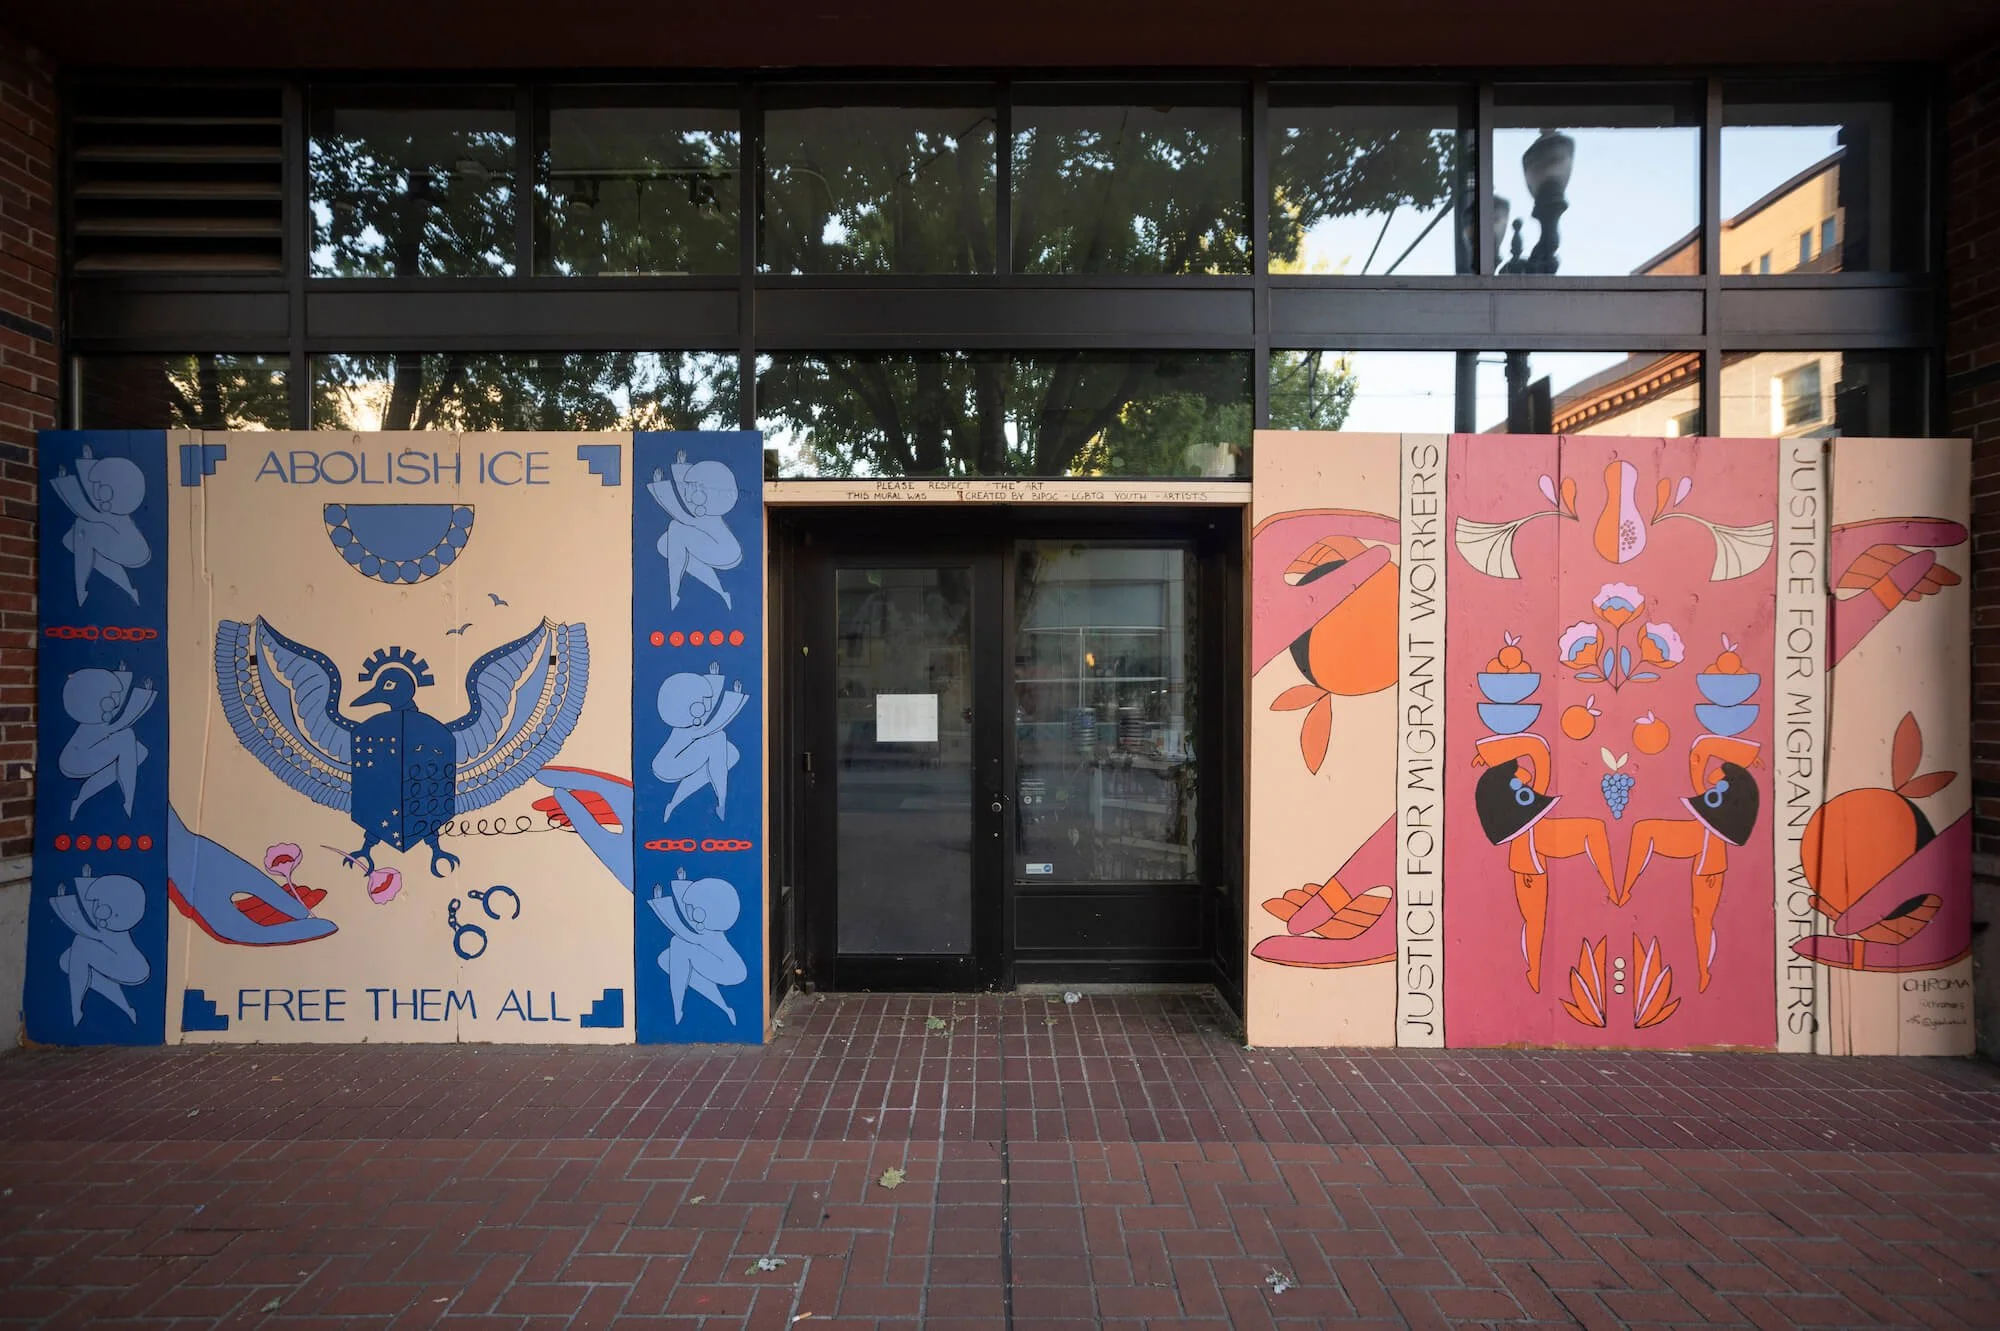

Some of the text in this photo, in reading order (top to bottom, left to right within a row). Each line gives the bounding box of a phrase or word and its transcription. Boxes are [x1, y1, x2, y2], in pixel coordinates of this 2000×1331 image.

[254, 450, 551, 486] ABOLISH ICE
[876, 482, 914, 490] PLEASE
[928, 481, 971, 490] RESPECT
[991, 481, 1014, 490] THE
[847, 492, 869, 500] THIS
[873, 492, 901, 500] MURAL
[907, 492, 927, 500] WAS
[965, 491, 1006, 500] CREATED
[1012, 491, 1024, 500] BY
[1071, 491, 1104, 500] LGBTQ
[1114, 491, 1147, 500] YOUTH
[1163, 491, 1208, 500] ARTISTS
[1788, 447, 1817, 594] JUSTICE
[1786, 608, 1815, 680] FOR
[1406, 444, 1439, 1036] JUSTICE FOR MIGRANT WORKERS
[238, 988, 572, 1021] FREE THEM ALL
